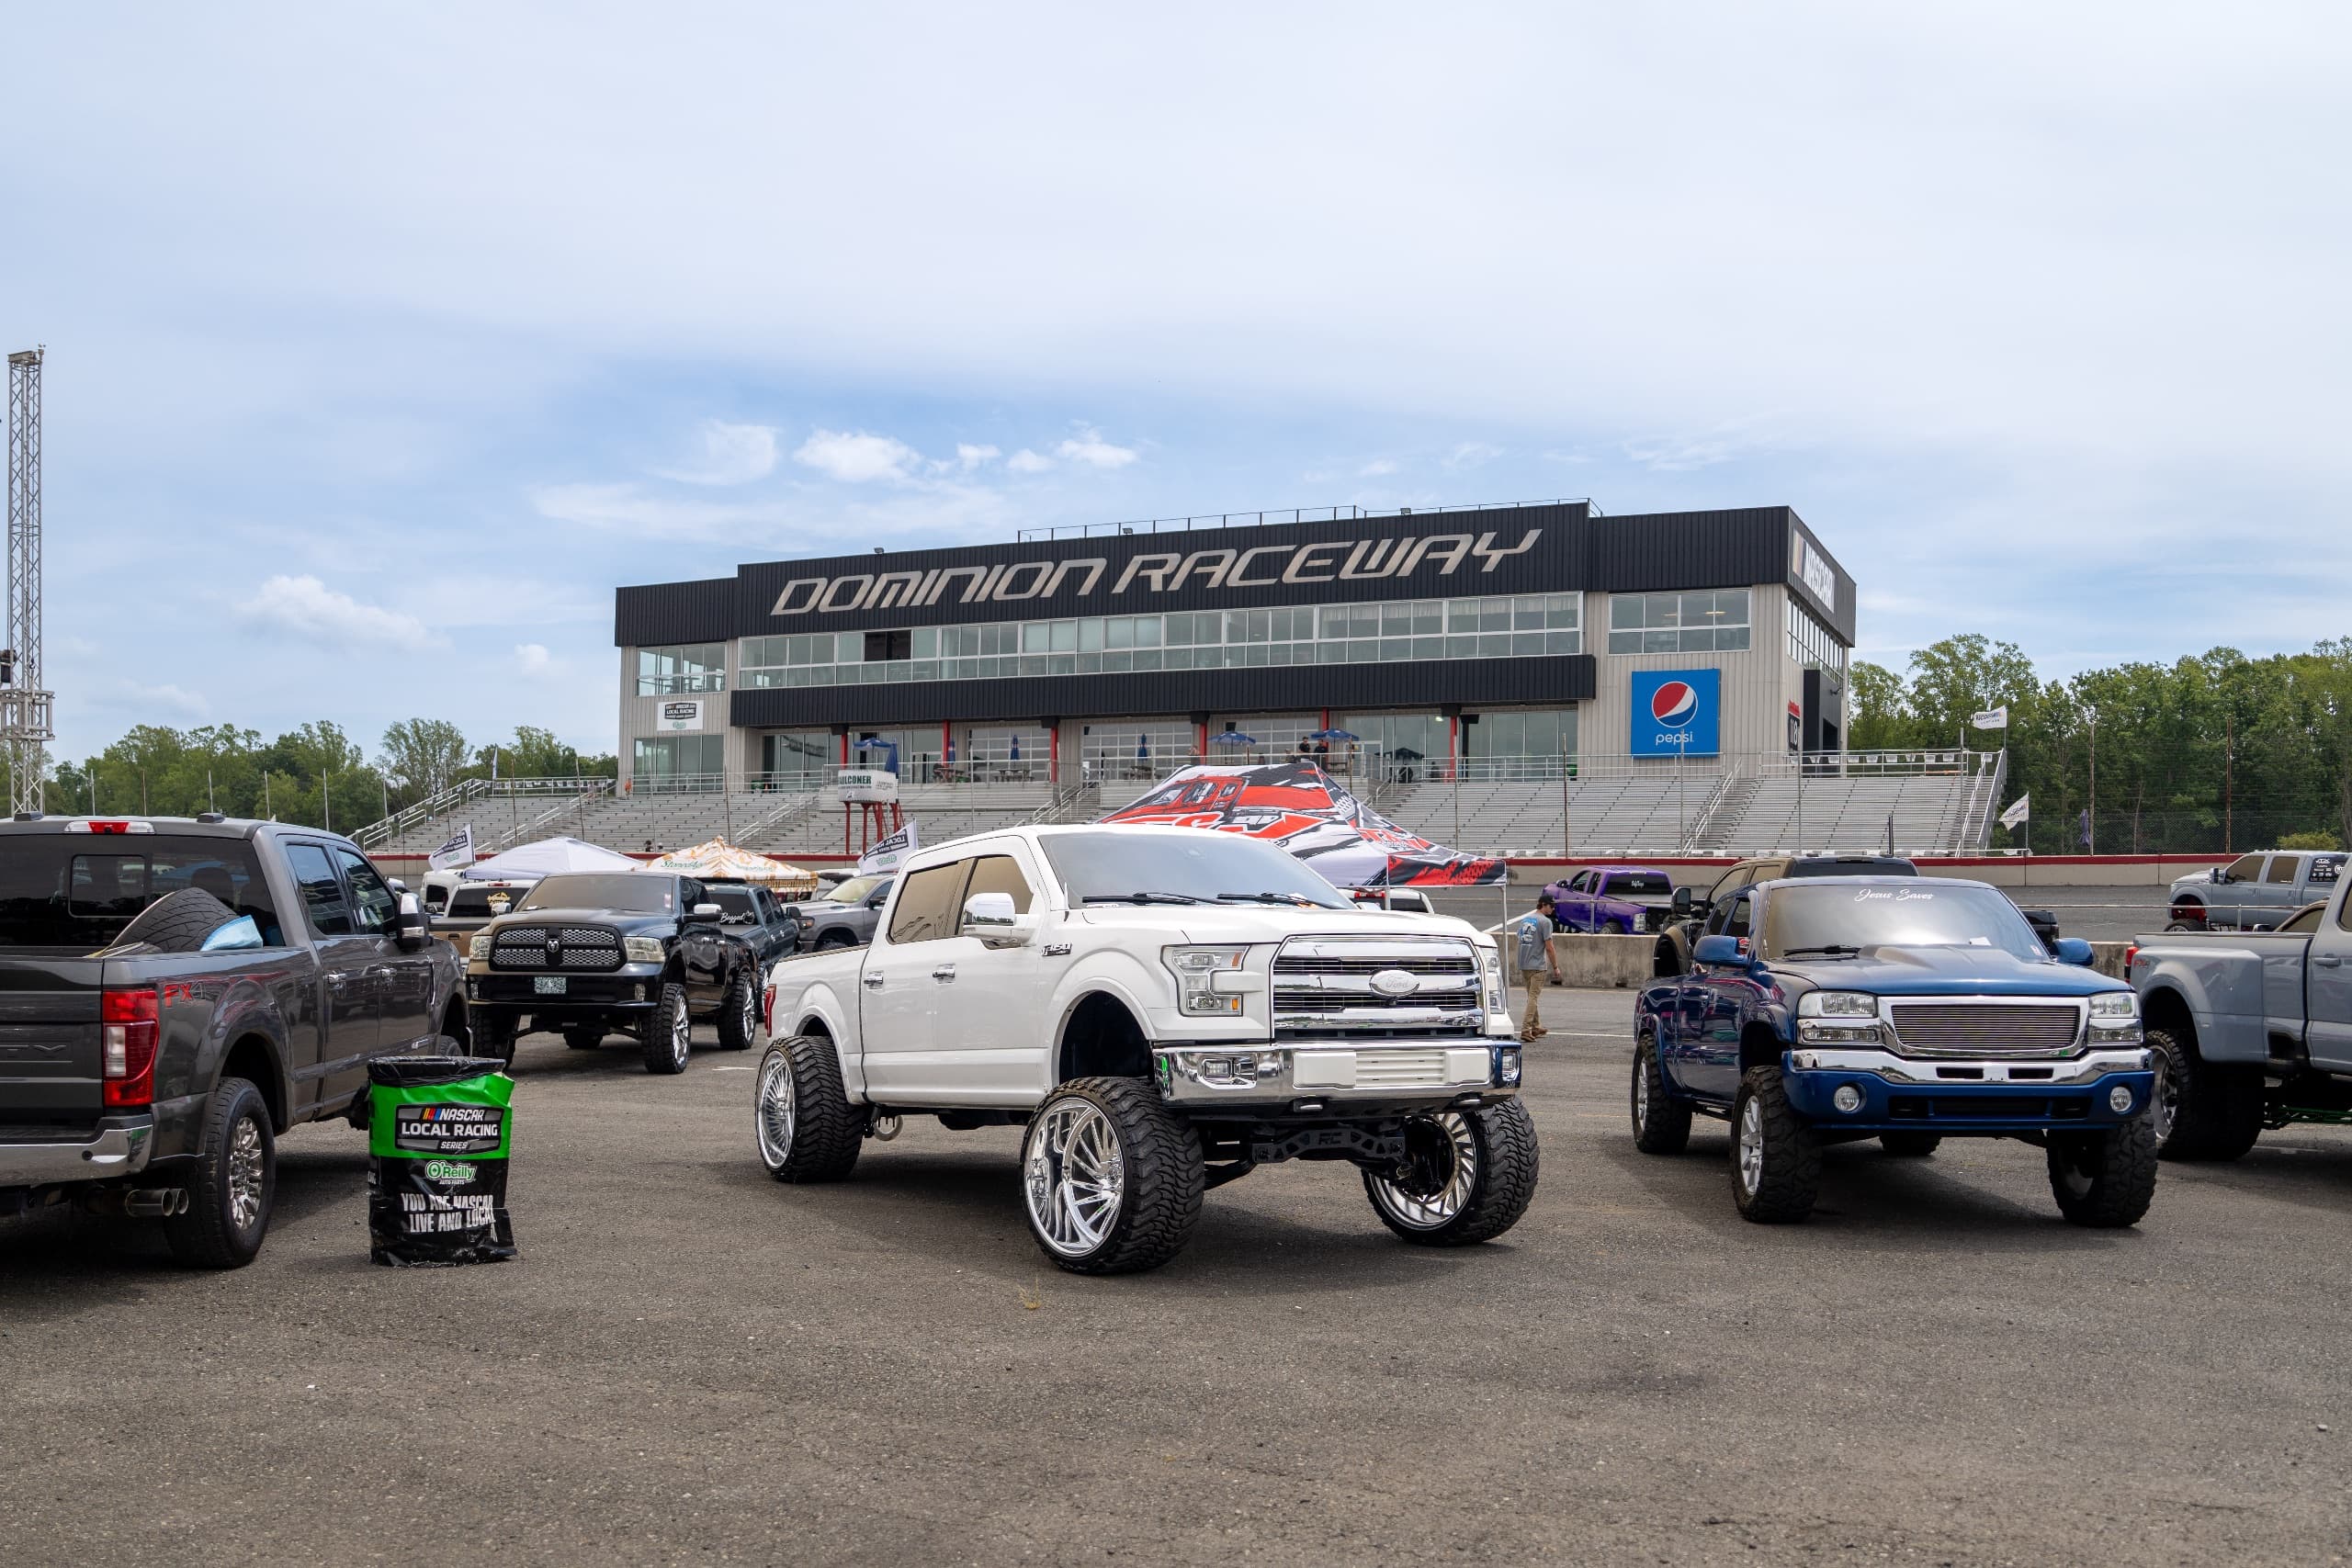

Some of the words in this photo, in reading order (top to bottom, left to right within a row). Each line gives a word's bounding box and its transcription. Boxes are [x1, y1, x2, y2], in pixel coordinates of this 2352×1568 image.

[770, 557, 1107, 615] DOMINION
[1111, 529, 1544, 594] RACEWAY
[1804, 541, 1835, 614] NASCAR
[1656, 731, 1693, 746] pepsi
[1854, 888, 1893, 901] Jesus
[1896, 888, 1934, 901] Saves
[163, 981, 207, 1008] FX4
[439, 1108, 485, 1122] NASCAR
[401, 1122, 450, 1136] LOCAL
[453, 1123, 498, 1136] RACING
[440, 1141, 469, 1149] SERIES
[426, 1161, 476, 1180] O'Reilly
[401, 1192, 426, 1212] YOU
[428, 1194, 454, 1211] ARE
[453, 1194, 493, 1210] NASCAR
[409, 1213, 435, 1233] LIVE
[438, 1212, 462, 1232] AND
